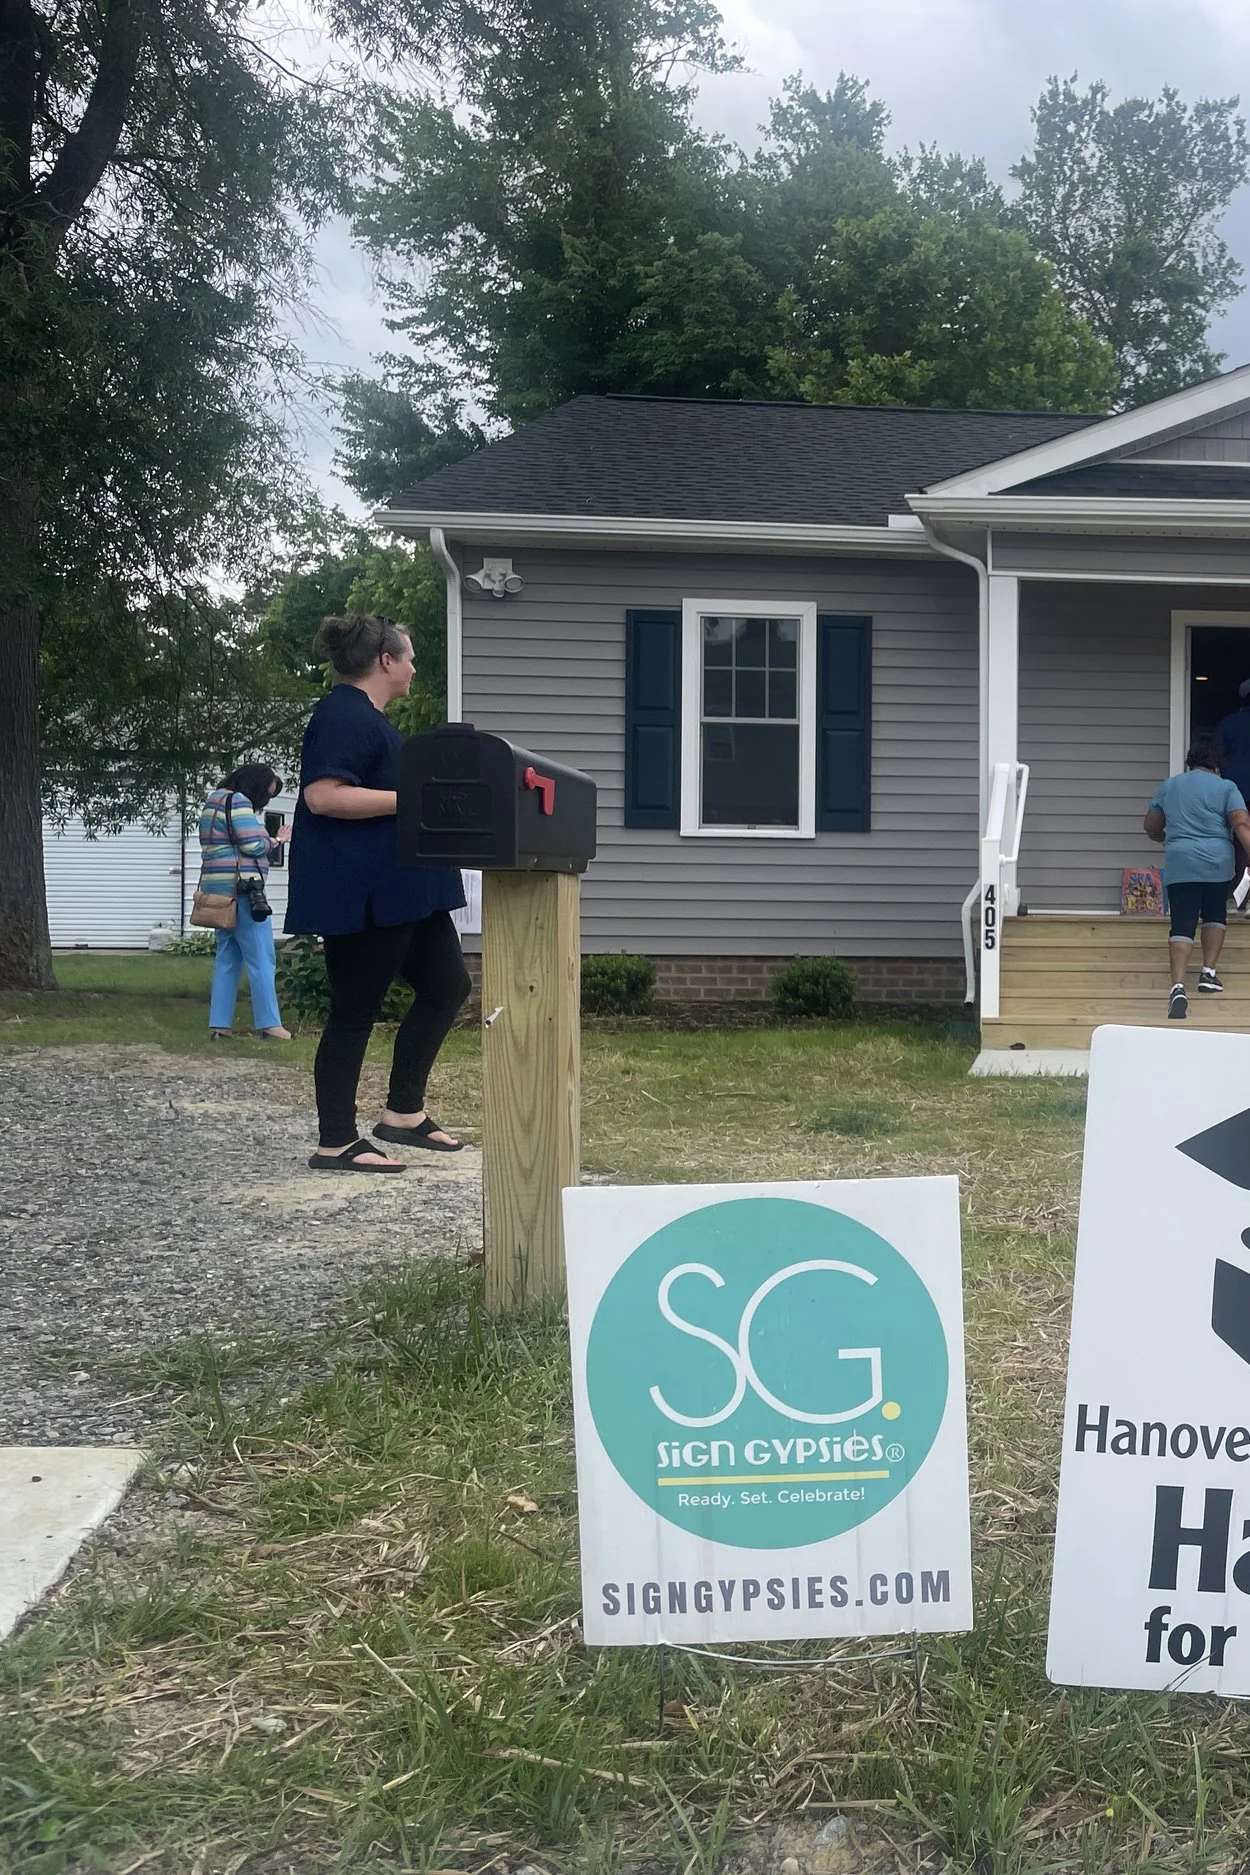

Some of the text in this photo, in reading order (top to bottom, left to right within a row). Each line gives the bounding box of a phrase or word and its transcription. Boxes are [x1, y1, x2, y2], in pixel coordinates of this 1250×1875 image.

[984, 884, 996, 950] 405
[678, 1487, 866, 1508] Ready. Set. Celebrate!
[602, 1569, 950, 1616] SIGNGYPSIES.COM
[1144, 1605, 1237, 1667] for
